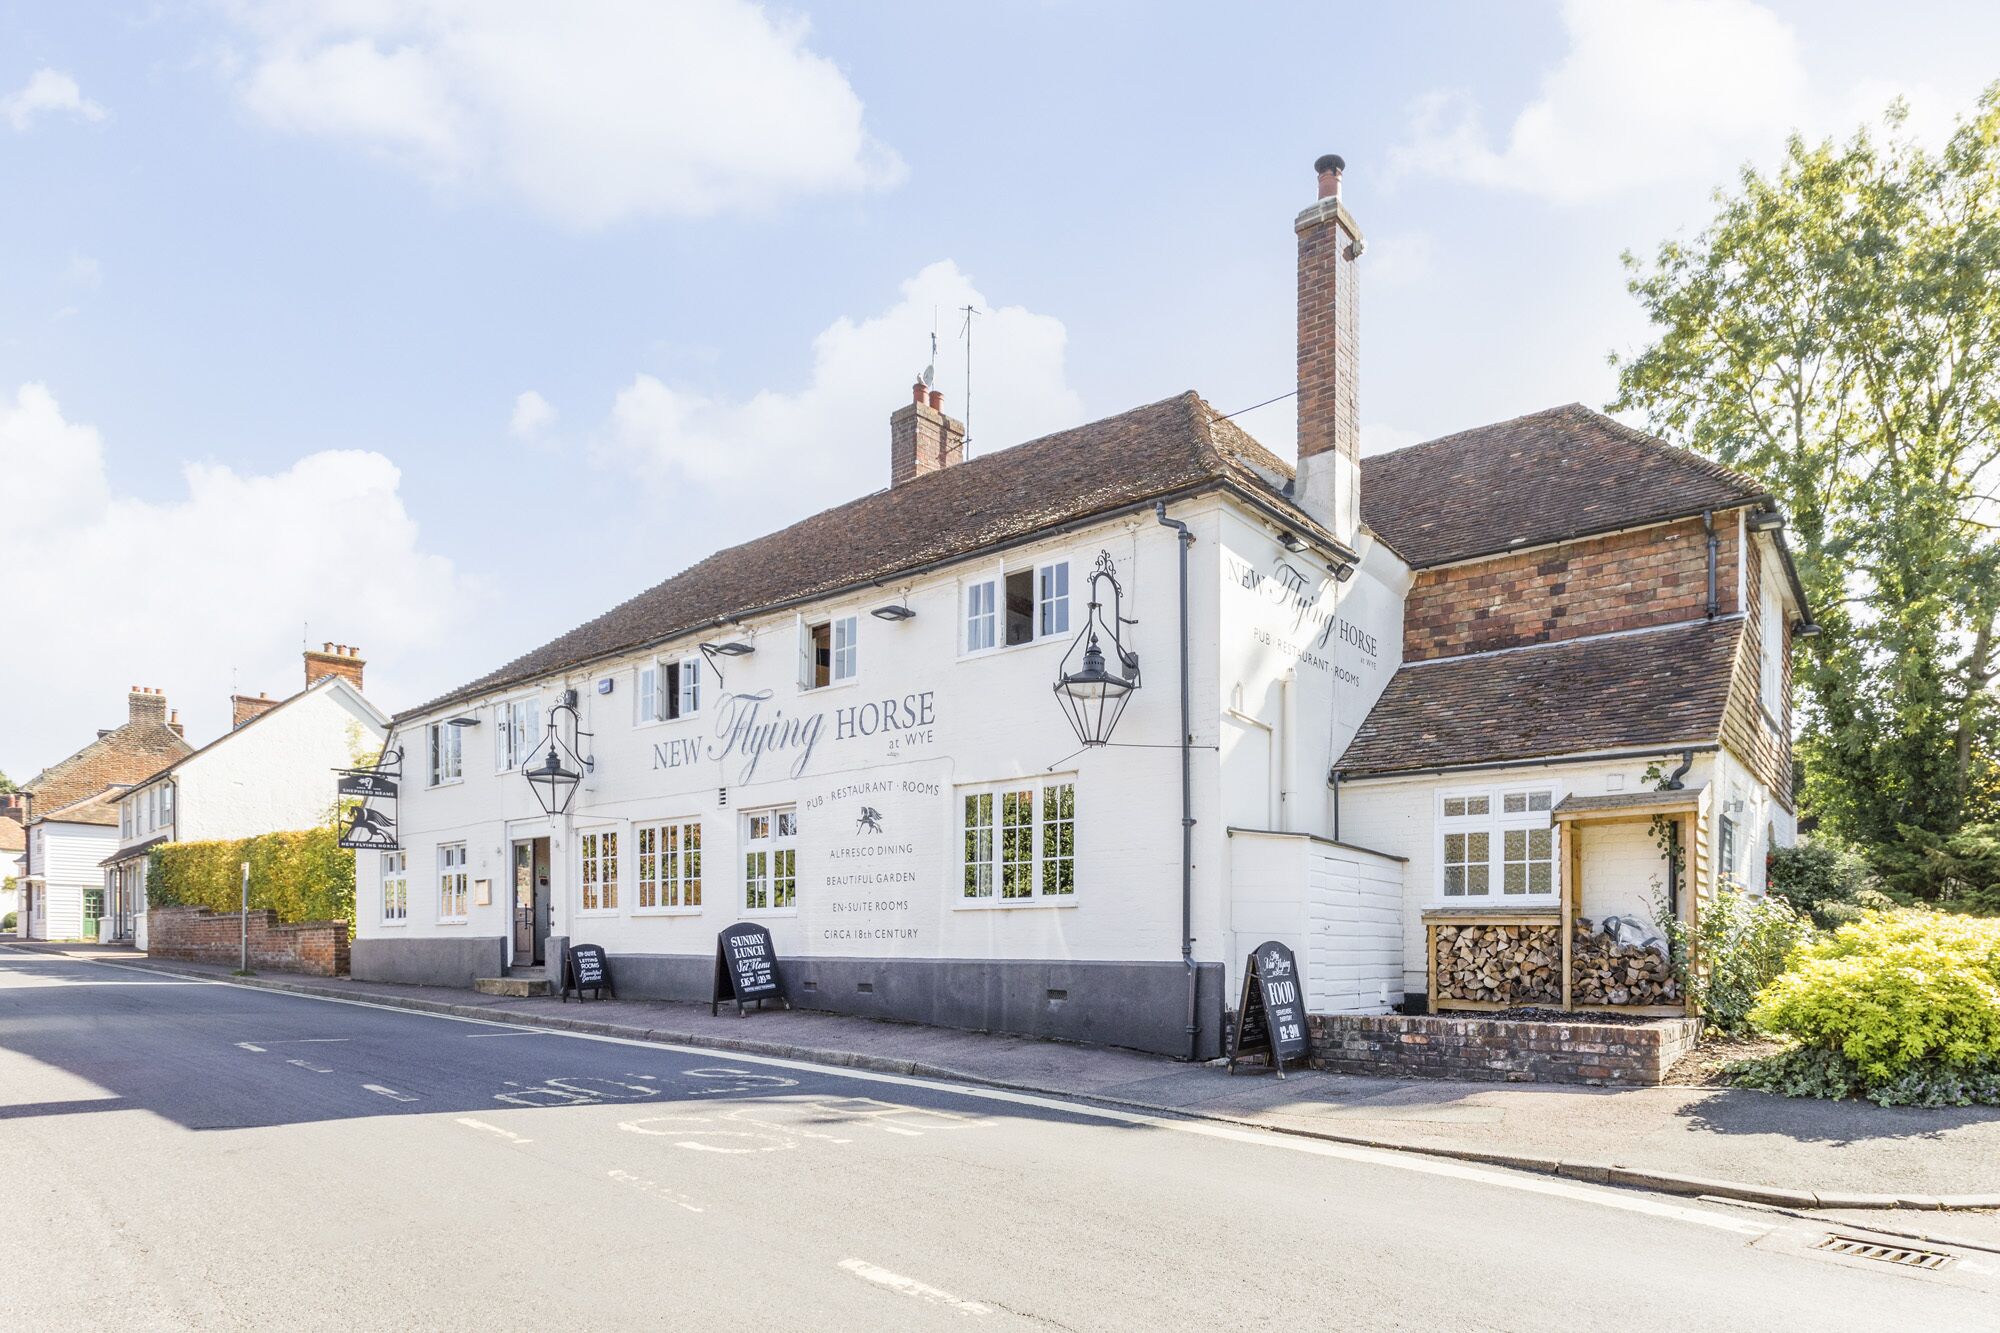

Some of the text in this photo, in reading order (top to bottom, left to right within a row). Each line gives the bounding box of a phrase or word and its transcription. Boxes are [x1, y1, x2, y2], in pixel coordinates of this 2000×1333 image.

[1228, 556, 1378, 658] NEW Flying HORSE
[1253, 627, 1360, 688] PUB RESTAURANT ROOMS
[652, 688, 936, 787] NEW Flying HORSE
[888, 729, 934, 750] at WYE
[806, 780, 939, 811] PUB RESTAURANT ROOMS
[830, 844, 913, 859] ALFRESCO DINING
[826, 872, 916, 887] BEAUTIFUL GARDEN
[832, 900, 909, 912] EN-SUITE ROOMS
[731, 934, 764, 947] SUNDAY
[823, 928, 918, 940] CIRCA 18th CENTURY
[734, 945, 765, 958] LUNCH
[1267, 981, 1295, 1006] FOOD
[619, 1097, 998, 1154] BUS
